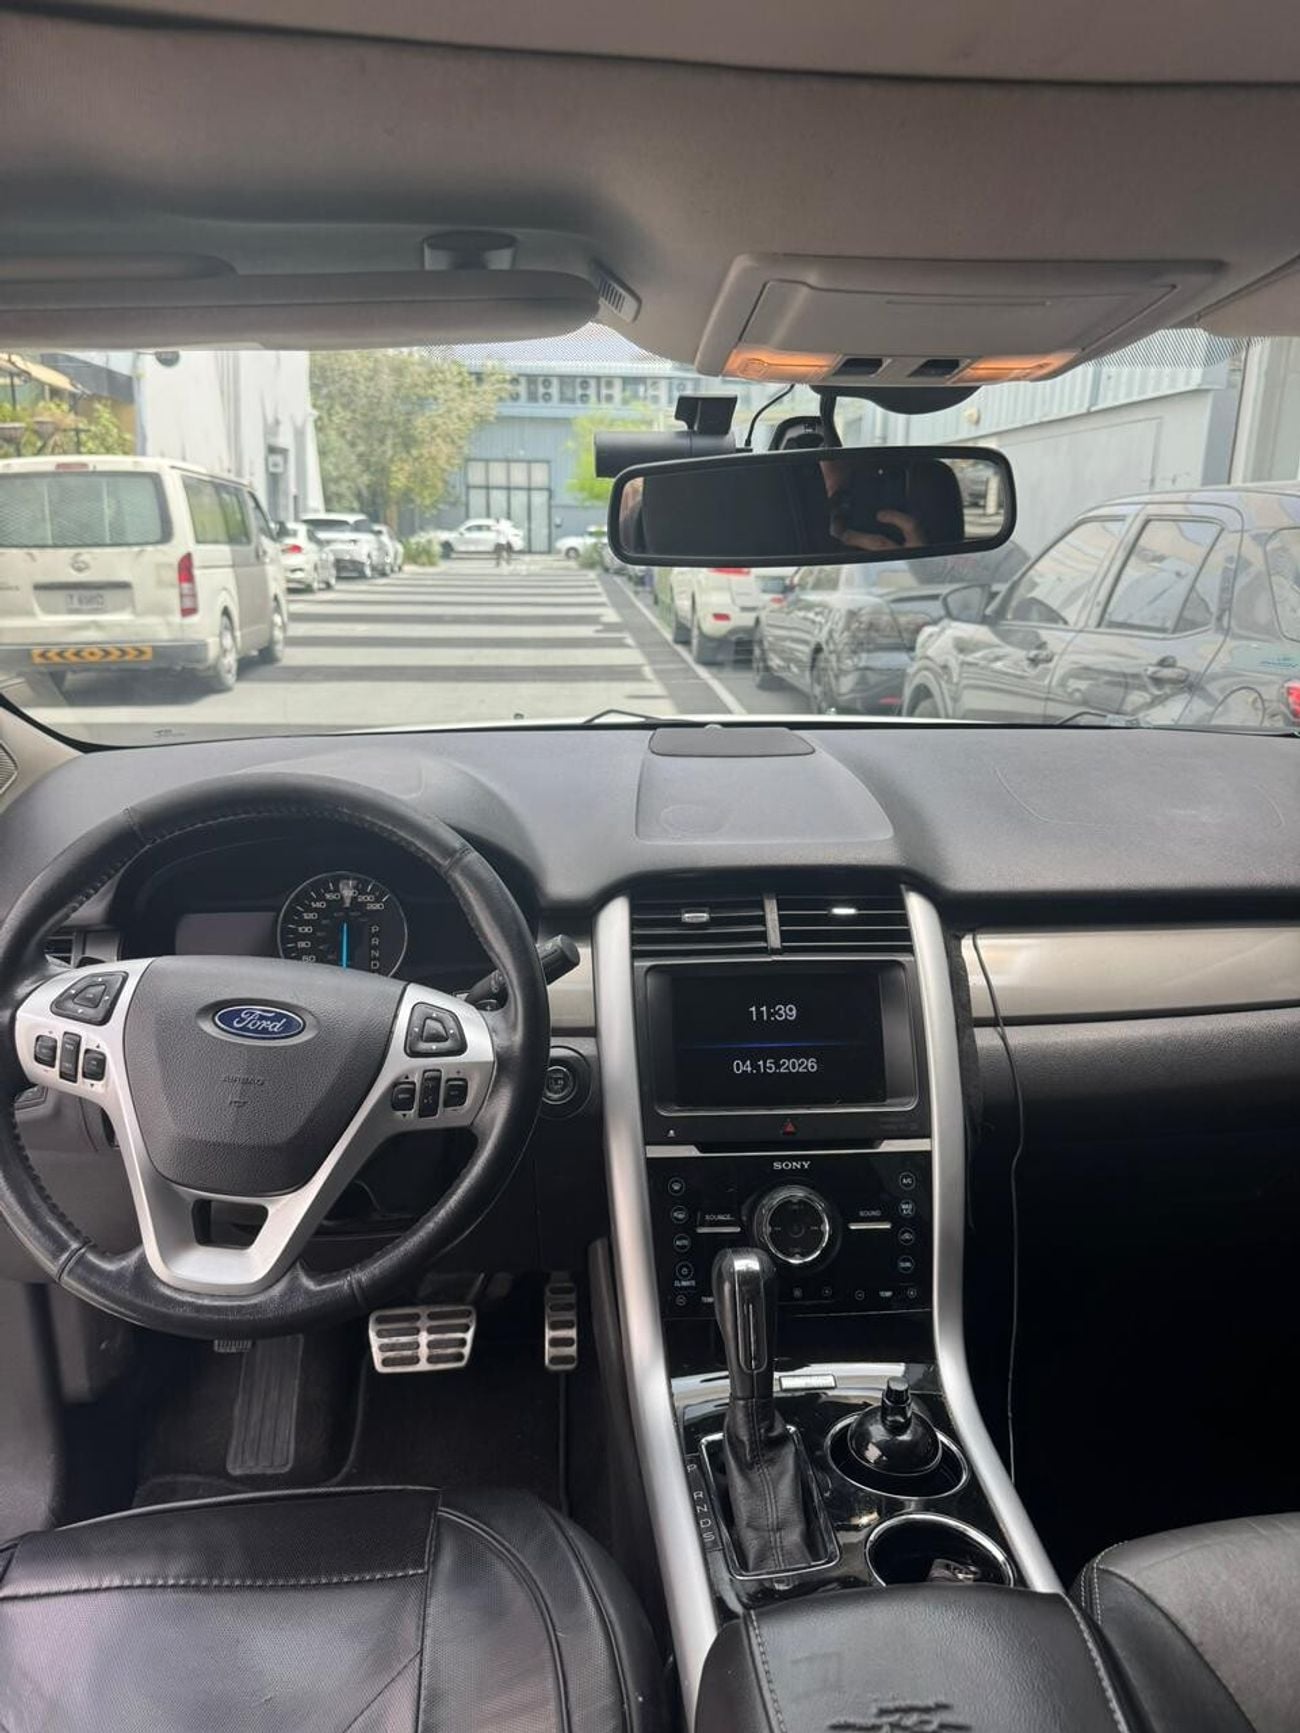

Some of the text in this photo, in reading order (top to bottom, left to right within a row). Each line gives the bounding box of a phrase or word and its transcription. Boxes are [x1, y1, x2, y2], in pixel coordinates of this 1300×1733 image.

[311, 901, 326, 909] 140
[298, 926, 313, 934] 100
[370, 950, 380, 958] N
[370, 961, 380, 970] D
[749, 1004, 797, 1021] 11:39
[233, 1009, 287, 1032] Ford
[733, 1057, 818, 1074] 04.15.2026
[773, 1161, 810, 1170] SONY
[686, 1464, 698, 1472] P
[696, 1504, 708, 1512] N
[700, 1518, 712, 1528] D
[702, 1532, 715, 1542] S
